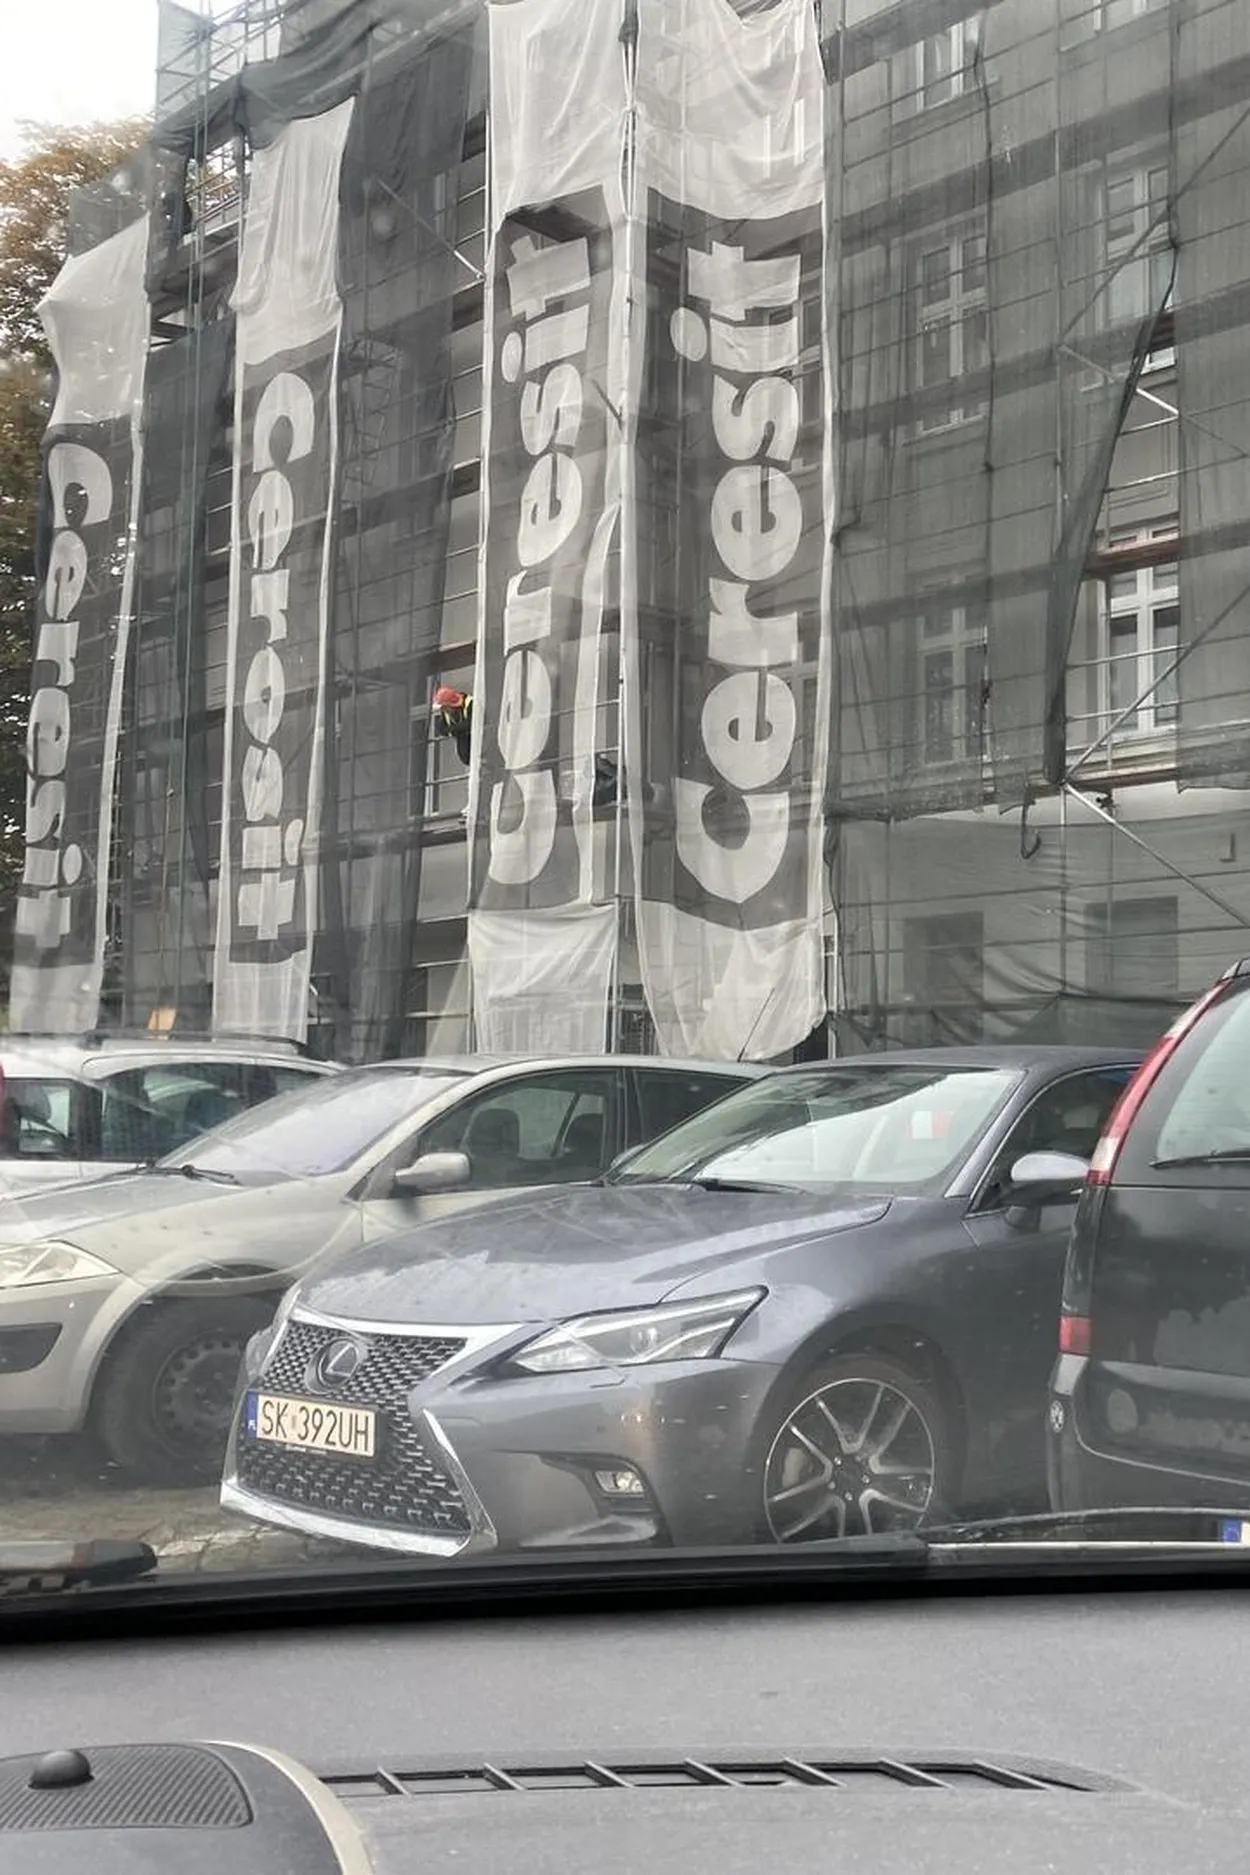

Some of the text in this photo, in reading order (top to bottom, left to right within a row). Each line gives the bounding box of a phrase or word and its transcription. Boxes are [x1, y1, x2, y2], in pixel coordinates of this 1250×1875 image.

[15, 442, 113, 948] Ceresit
[488, 237, 593, 884] Ceresit
[670, 242, 802, 904] Ceresit
[262, 1400, 369, 1451] SK 392UH
